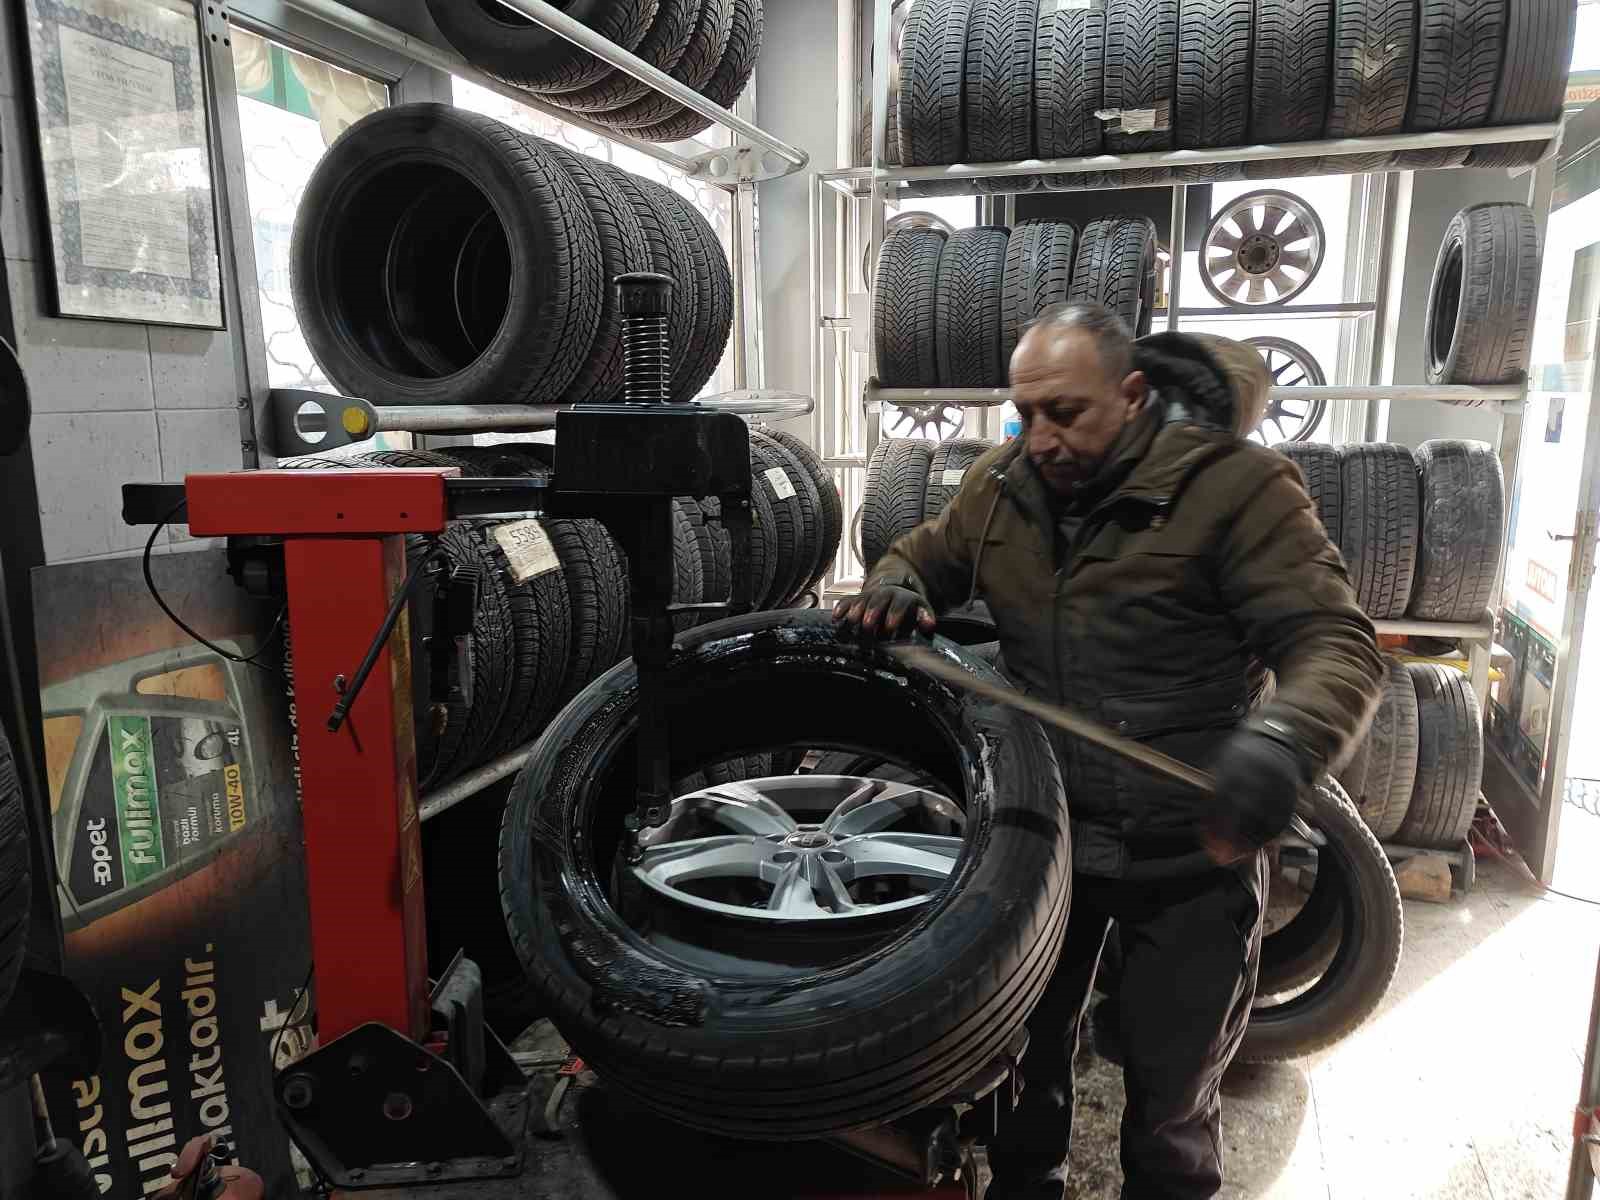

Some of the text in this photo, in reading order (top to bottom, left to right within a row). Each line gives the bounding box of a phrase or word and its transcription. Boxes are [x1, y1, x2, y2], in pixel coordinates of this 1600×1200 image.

[227, 727, 240, 746] 4L
[228, 768, 243, 826] 10W-40
[86, 817, 112, 885] opet
[121, 976, 178, 1200] ullmax
